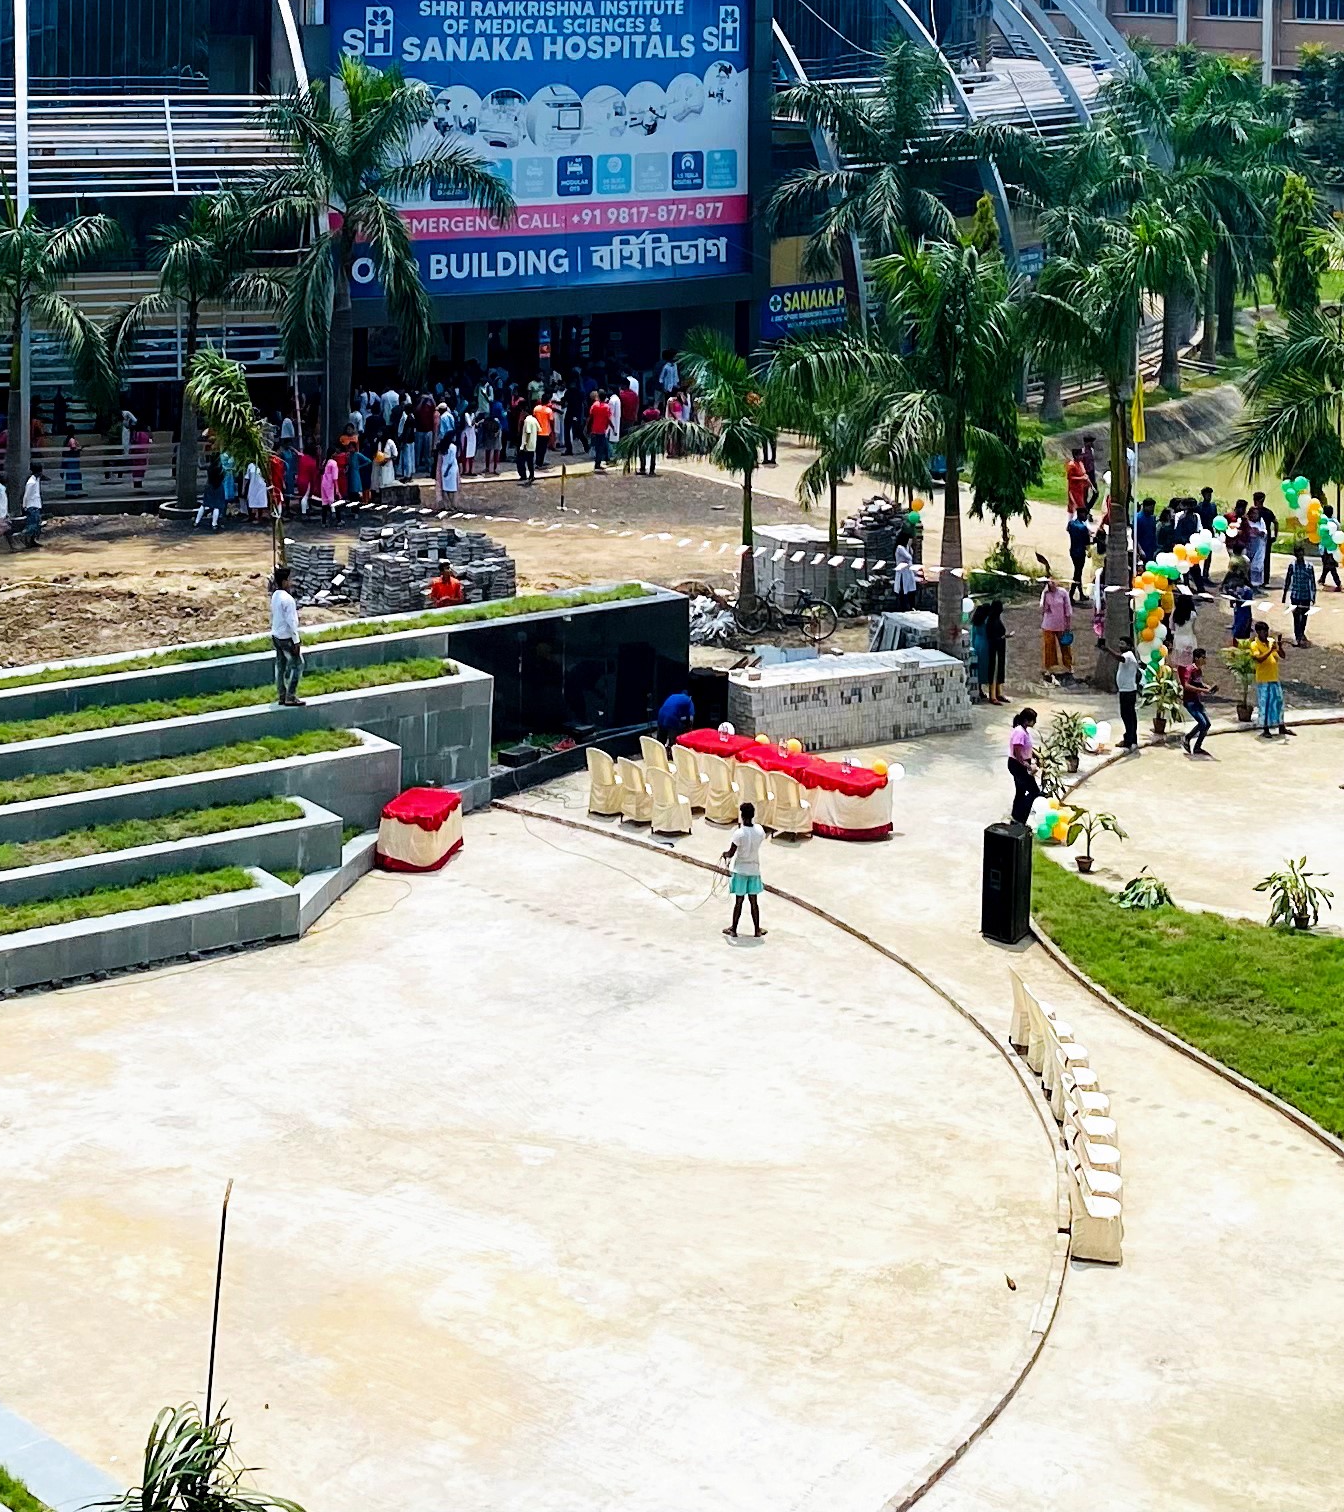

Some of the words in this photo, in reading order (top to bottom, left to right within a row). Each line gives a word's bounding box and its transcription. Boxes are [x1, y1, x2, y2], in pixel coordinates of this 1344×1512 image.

[419, 0, 465, 17] SHRI
[470, 0, 596, 17] RAMKRISHNA
[600, 0, 684, 16] INSTITUTE
[443, 18, 469, 35] OF
[474, 18, 558, 34] MEDICAL
[562, 17, 646, 34] SCIENCES
[649, 17, 662, 33] &
[402, 36, 534, 62] SANAKA
[543, 34, 695, 61] HOSPITALS
[401, 215, 512, 234] MERGENC
[571, 208, 601, 225] +91
[607, 202, 724, 224] 9817-877-877
[429, 248, 569, 280] BUILDING
[783, 288, 835, 313] SANAKA
